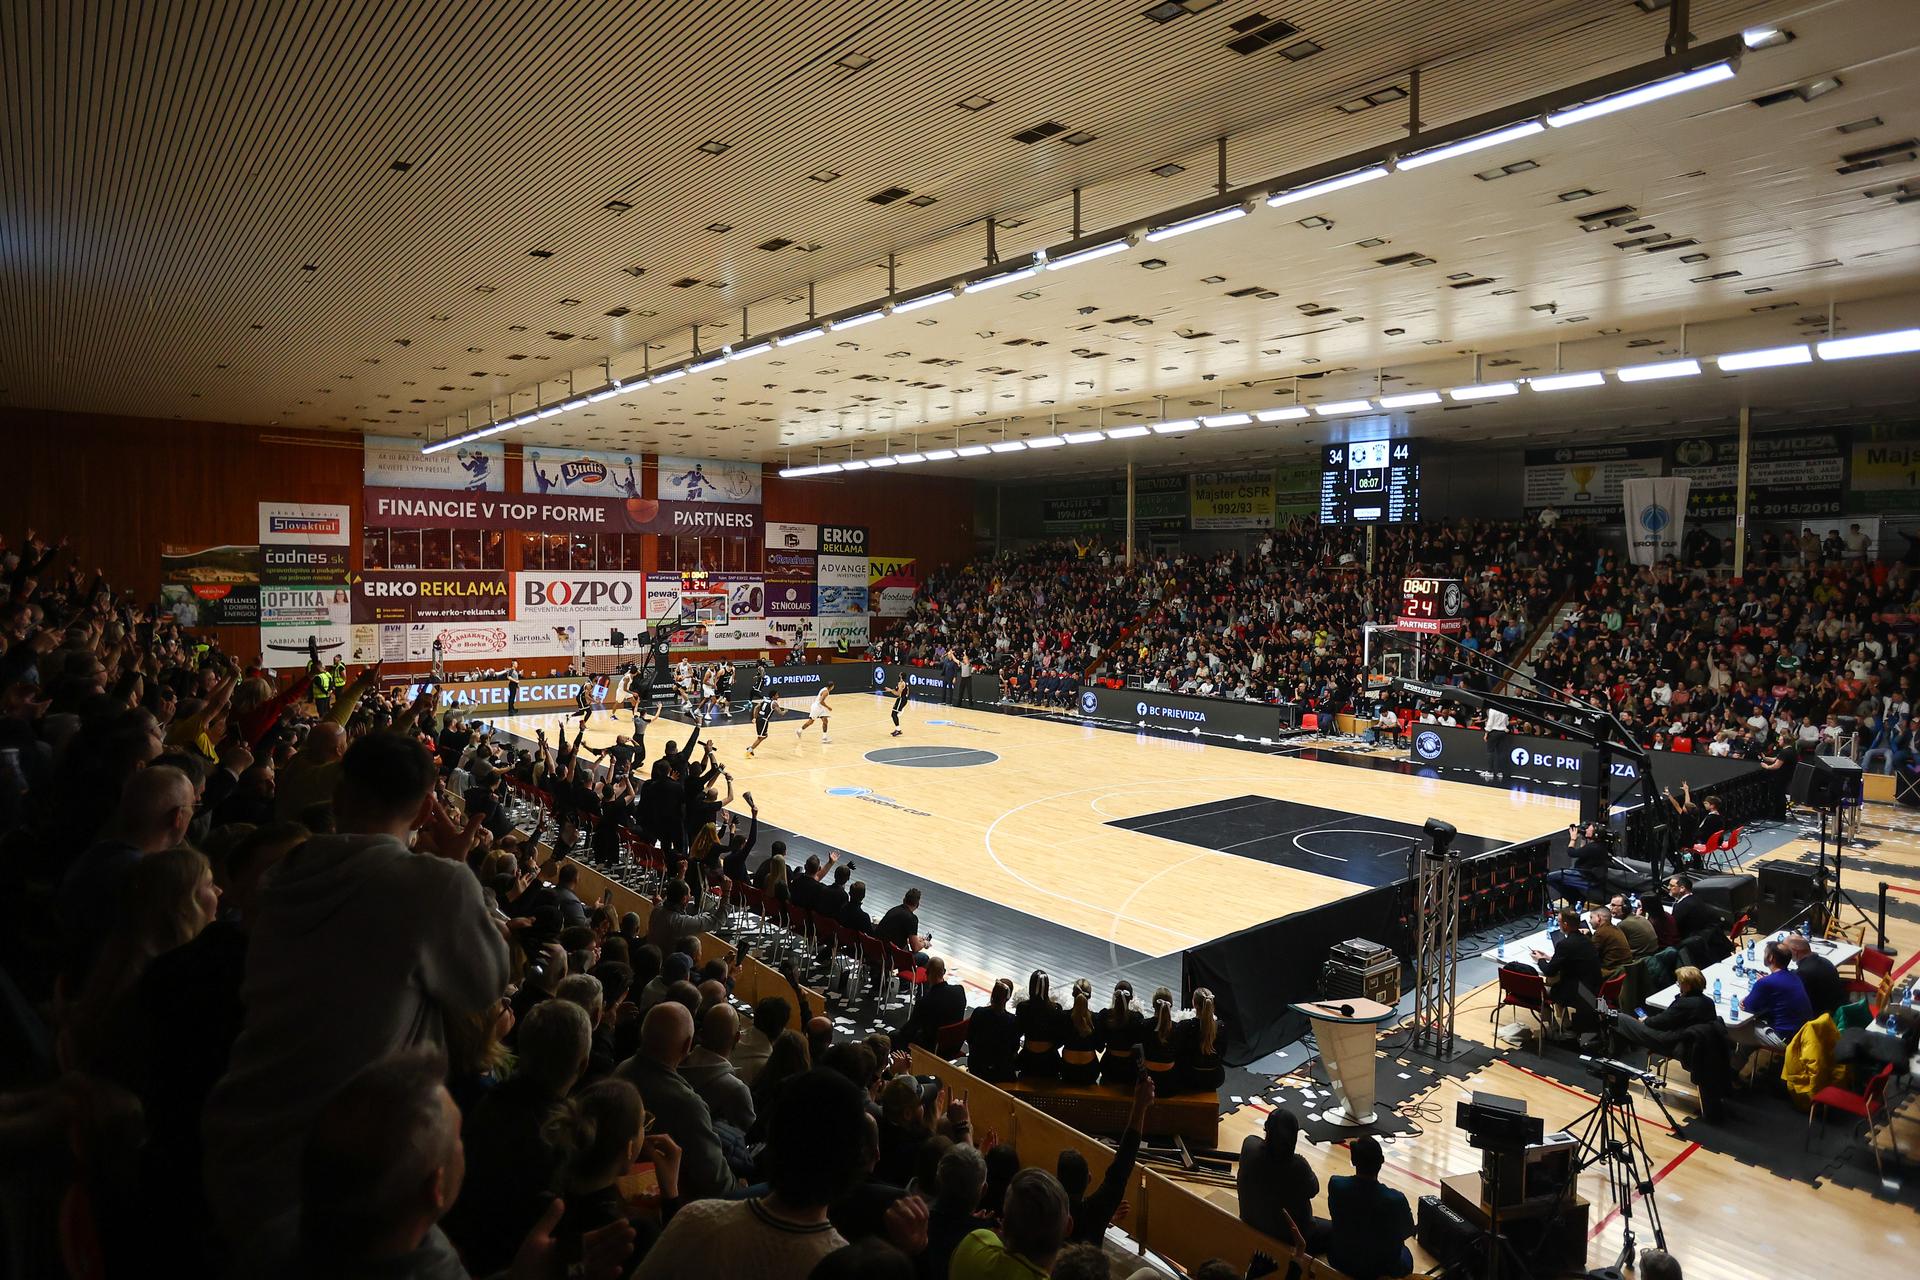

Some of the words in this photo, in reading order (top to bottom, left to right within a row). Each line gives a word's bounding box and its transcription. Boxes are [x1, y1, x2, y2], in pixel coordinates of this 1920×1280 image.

[1329, 449, 1343, 464] 34
[1393, 444, 1408, 460] 44
[1359, 478, 1379, 488] 08:07
[1196, 490, 1234, 502] Majster
[378, 499, 478, 518] FINANCIE
[481, 503, 495, 518] V
[499, 504, 538, 520] TOP
[542, 506, 605, 523] FORME
[1212, 502, 1252, 514] 1992/93
[1766, 502, 1840, 514] 2015/2016
[274, 518, 335, 531] Slovaktual
[674, 511, 754, 528] PARTNERS
[823, 528, 864, 544] ERKO
[823, 544, 864, 554] REKLAMA
[364, 582, 417, 596] ERKO
[420, 581, 507, 596] REKLAMA
[694, 581, 706, 589] 24
[1404, 580, 1439, 594] 08:07
[262, 592, 324, 607] iOPTIKA
[525, 580, 632, 606] BOZPO
[417, 608, 506, 616] www.erko-reklama.sk
[780, 601, 811, 610] NICOLAUS
[1408, 600, 1432, 616] 24
[776, 622, 813, 631] humnt
[1400, 620, 1437, 630] PARTNERS
[772, 676, 782, 684] BC
[784, 674, 820, 683] PRIEVIDZA
[1149, 706, 1160, 716] BC
[1162, 708, 1206, 722] PRIEVIDZA
[1534, 753, 1552, 767] BC
